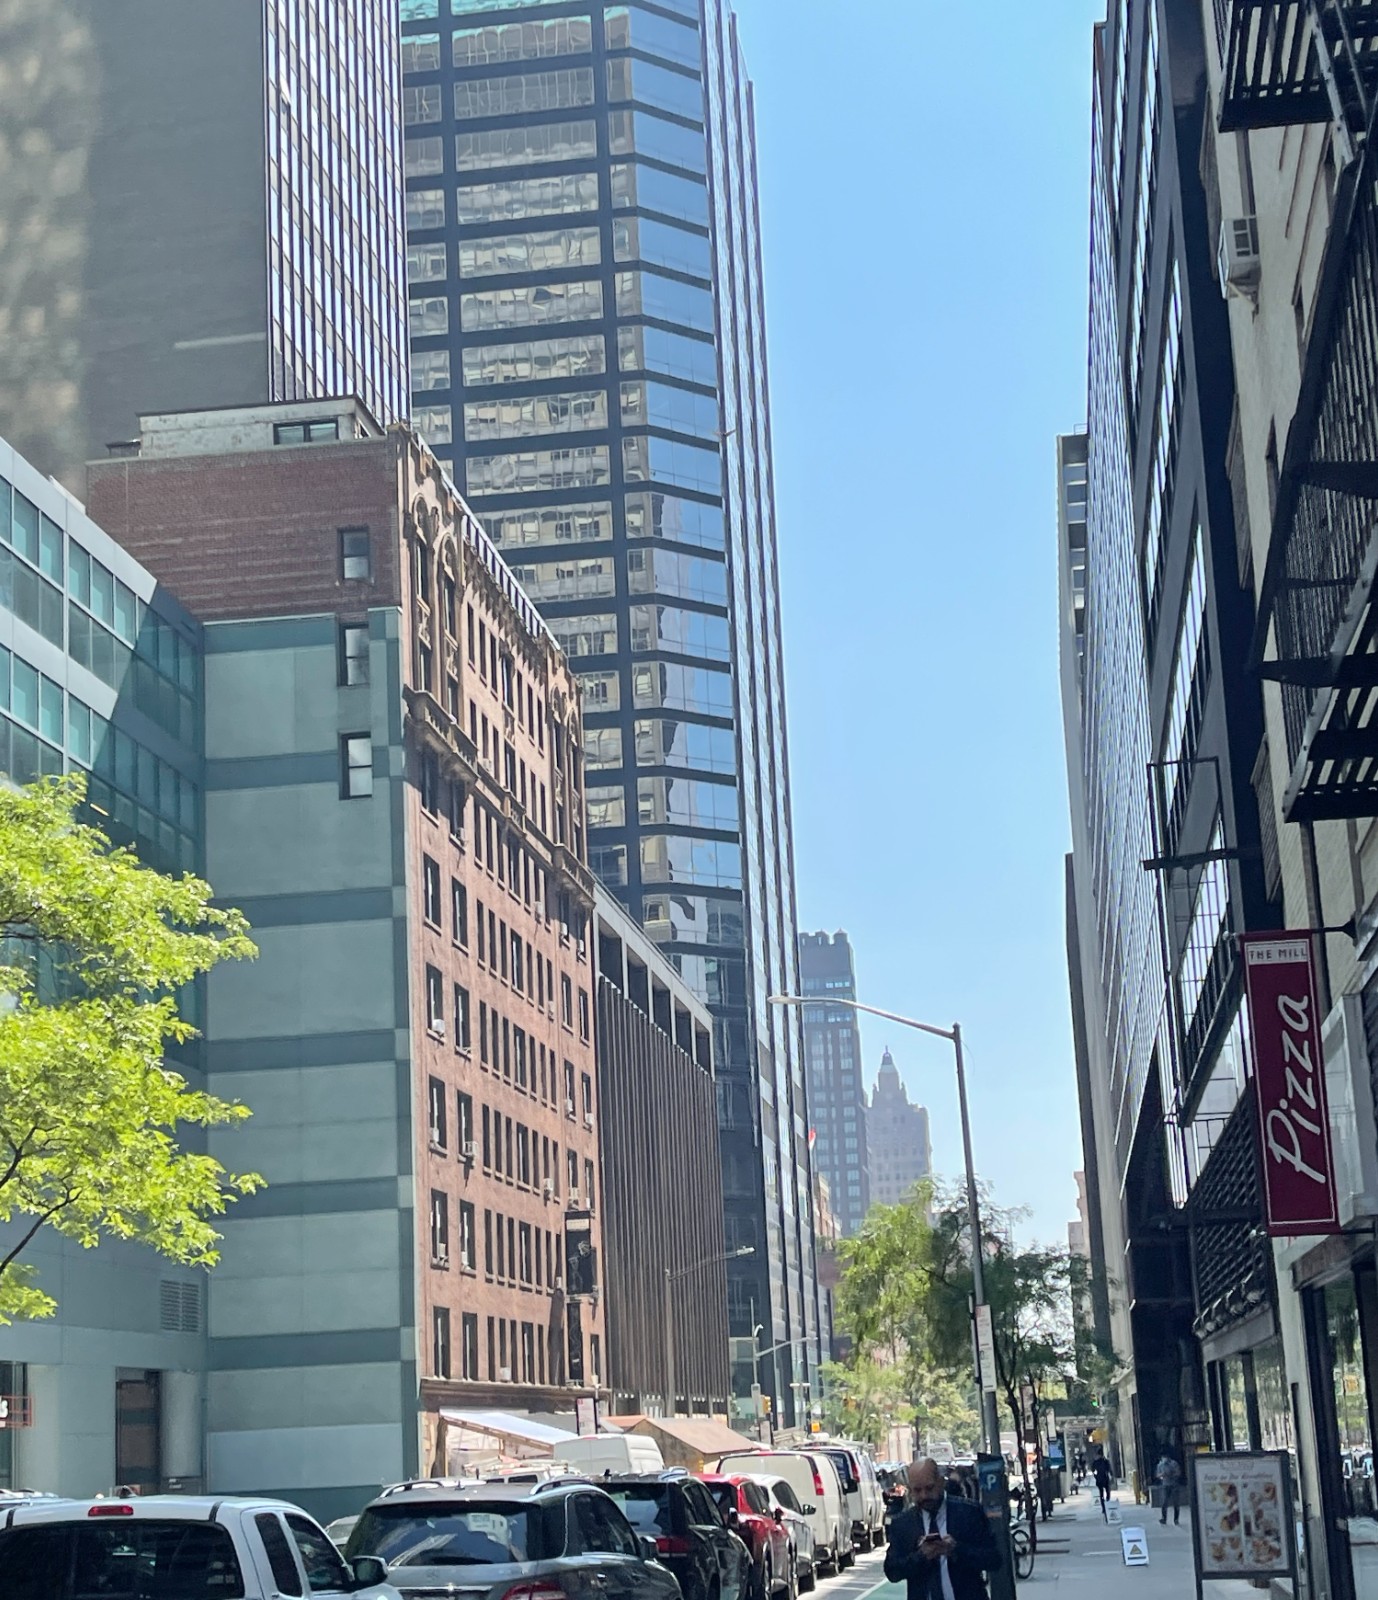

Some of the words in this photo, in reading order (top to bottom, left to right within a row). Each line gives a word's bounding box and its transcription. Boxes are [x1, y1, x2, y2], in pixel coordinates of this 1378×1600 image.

[1249, 949, 1272, 960] THE
[1278, 947, 1308, 958] MILL
[1267, 994, 1326, 1183] Pizza
[986, 1473, 997, 1491] P
